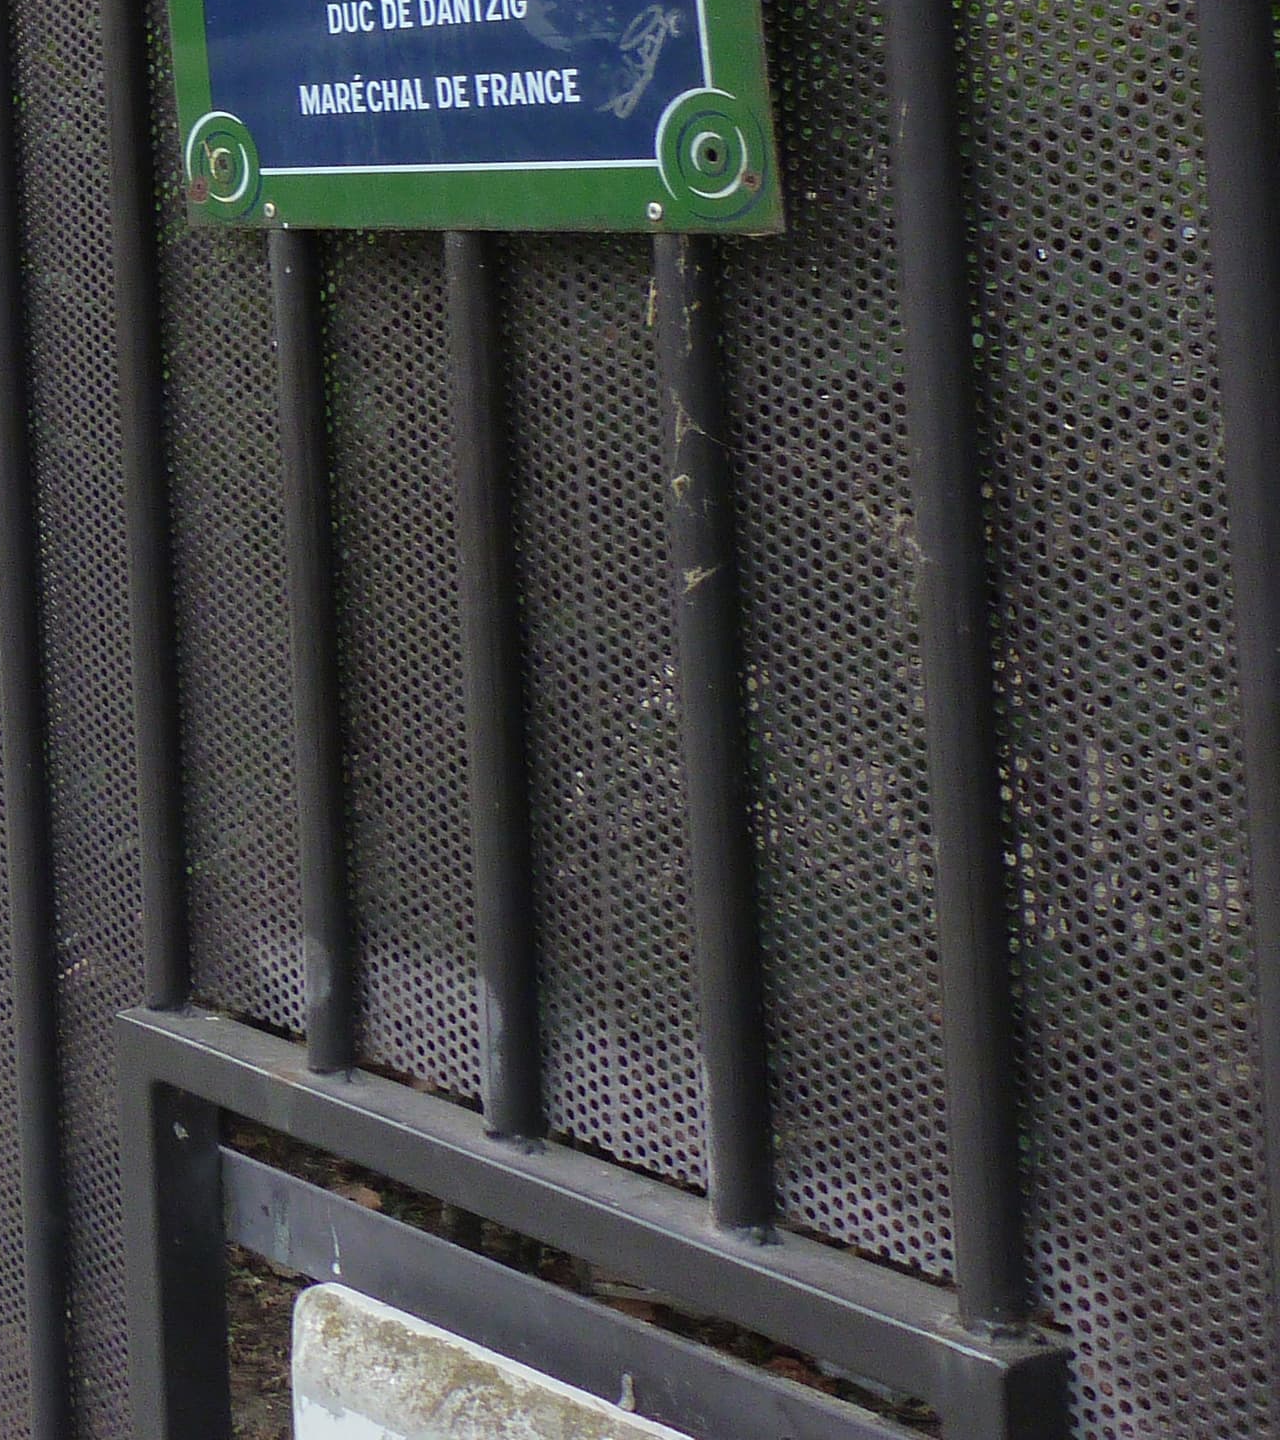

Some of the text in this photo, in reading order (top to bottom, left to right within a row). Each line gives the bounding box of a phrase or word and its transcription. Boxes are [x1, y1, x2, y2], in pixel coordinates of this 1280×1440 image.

[326, 0, 376, 35] DUC
[299, 67, 581, 116] MARÉCHAL DE FRANCE
